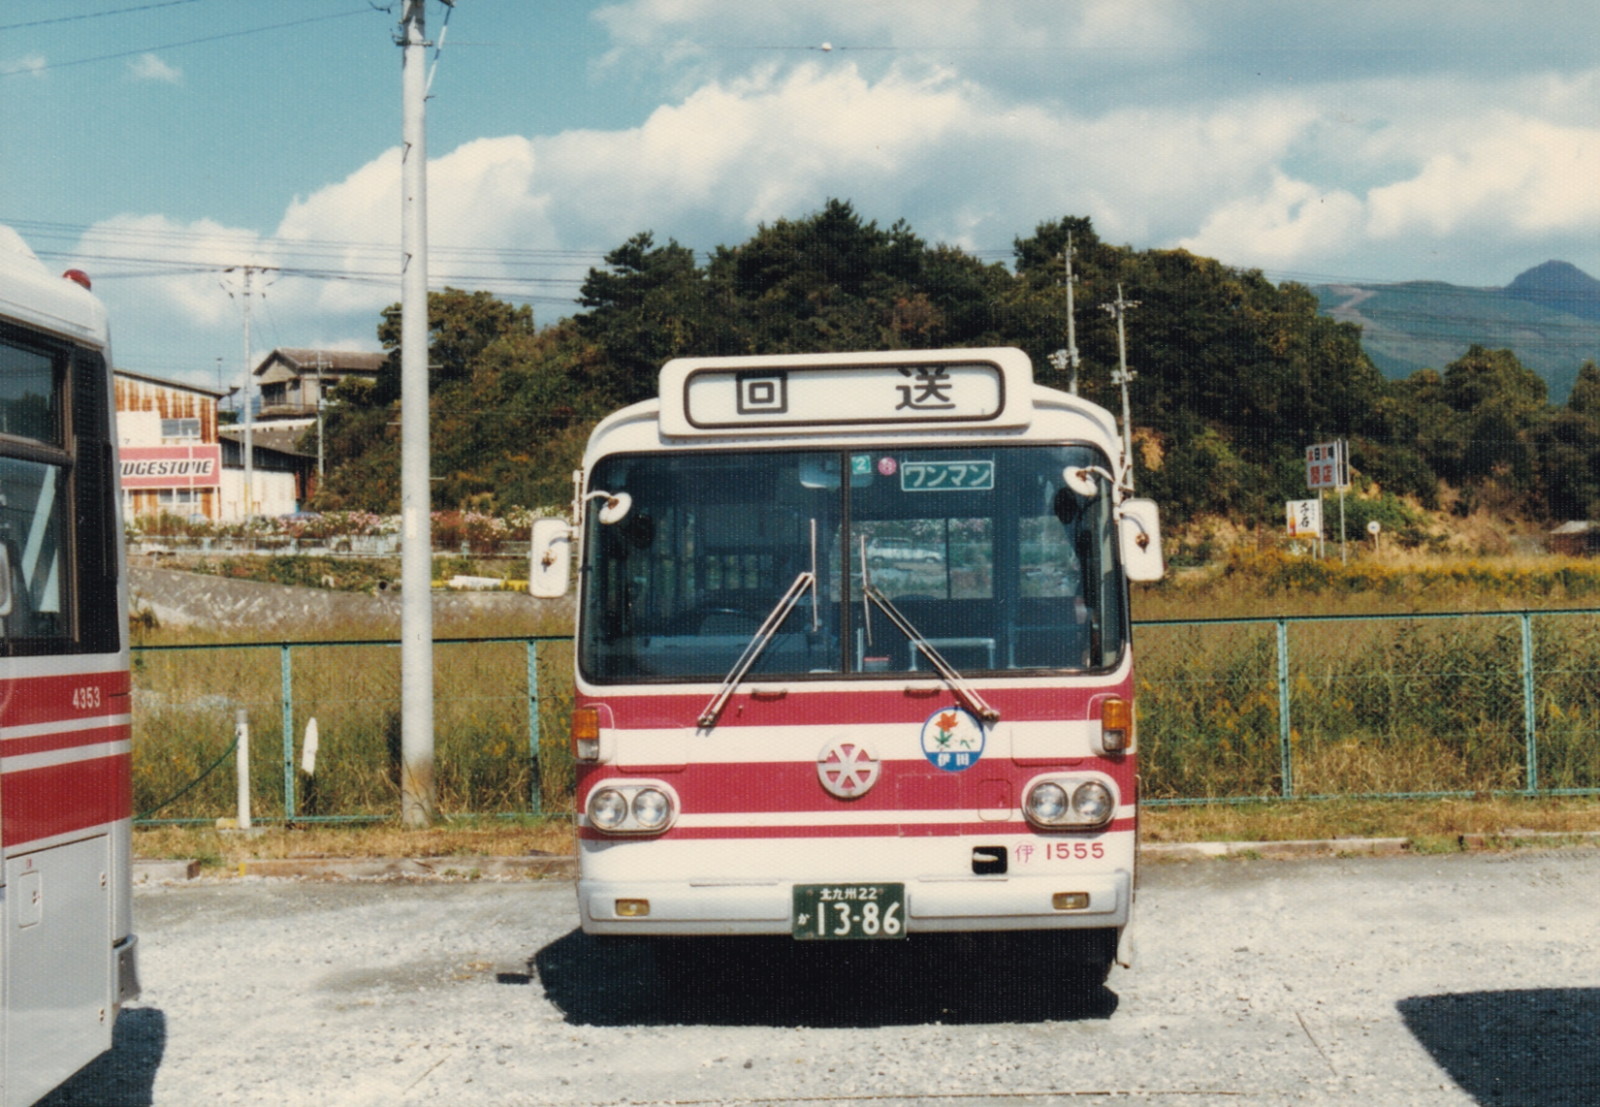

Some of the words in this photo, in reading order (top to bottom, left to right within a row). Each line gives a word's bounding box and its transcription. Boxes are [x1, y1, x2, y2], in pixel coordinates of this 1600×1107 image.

[735, 365, 956, 415] 回送
[905, 464, 990, 487] ワンマン
[73, 686, 100, 709] 4353
[1015, 844, 1034, 863] 伊
[1046, 842, 1105, 860] 1555
[818, 901, 901, 936] 13-86
